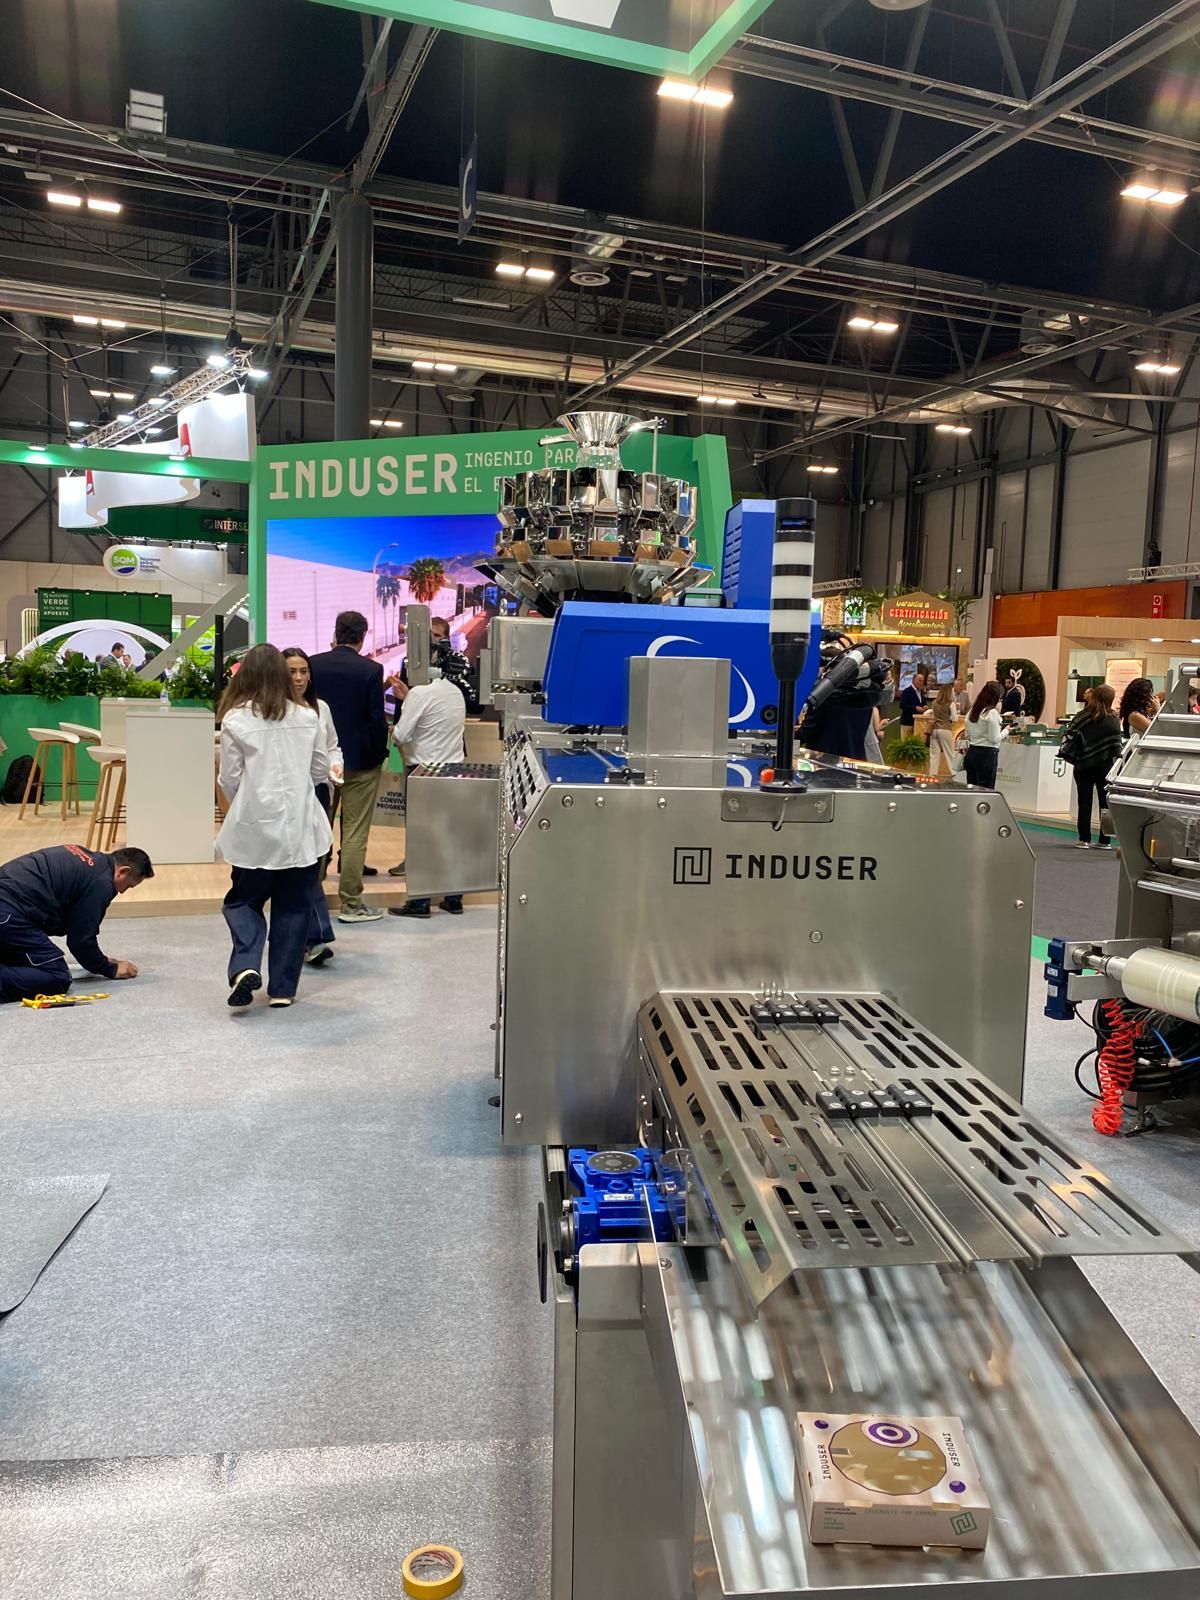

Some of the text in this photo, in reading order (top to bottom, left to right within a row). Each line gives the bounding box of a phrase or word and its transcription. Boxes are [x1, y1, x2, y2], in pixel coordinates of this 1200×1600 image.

[465, 450, 533, 468] INGENIO
[268, 452, 458, 500] INDUSER
[464, 477, 483, 493] EL
[214, 519, 248, 531] INTERSE
[112, 556, 135, 564] SQM
[43, 598, 69, 606] VERDE
[889, 607, 949, 620] CERTIFICACIÓN
[380, 796, 406, 804] CONVIV
[725, 854, 878, 881] INDUSER
[942, 1432, 961, 1467] INDUSER
[817, 1444, 832, 1480] INDUSER
